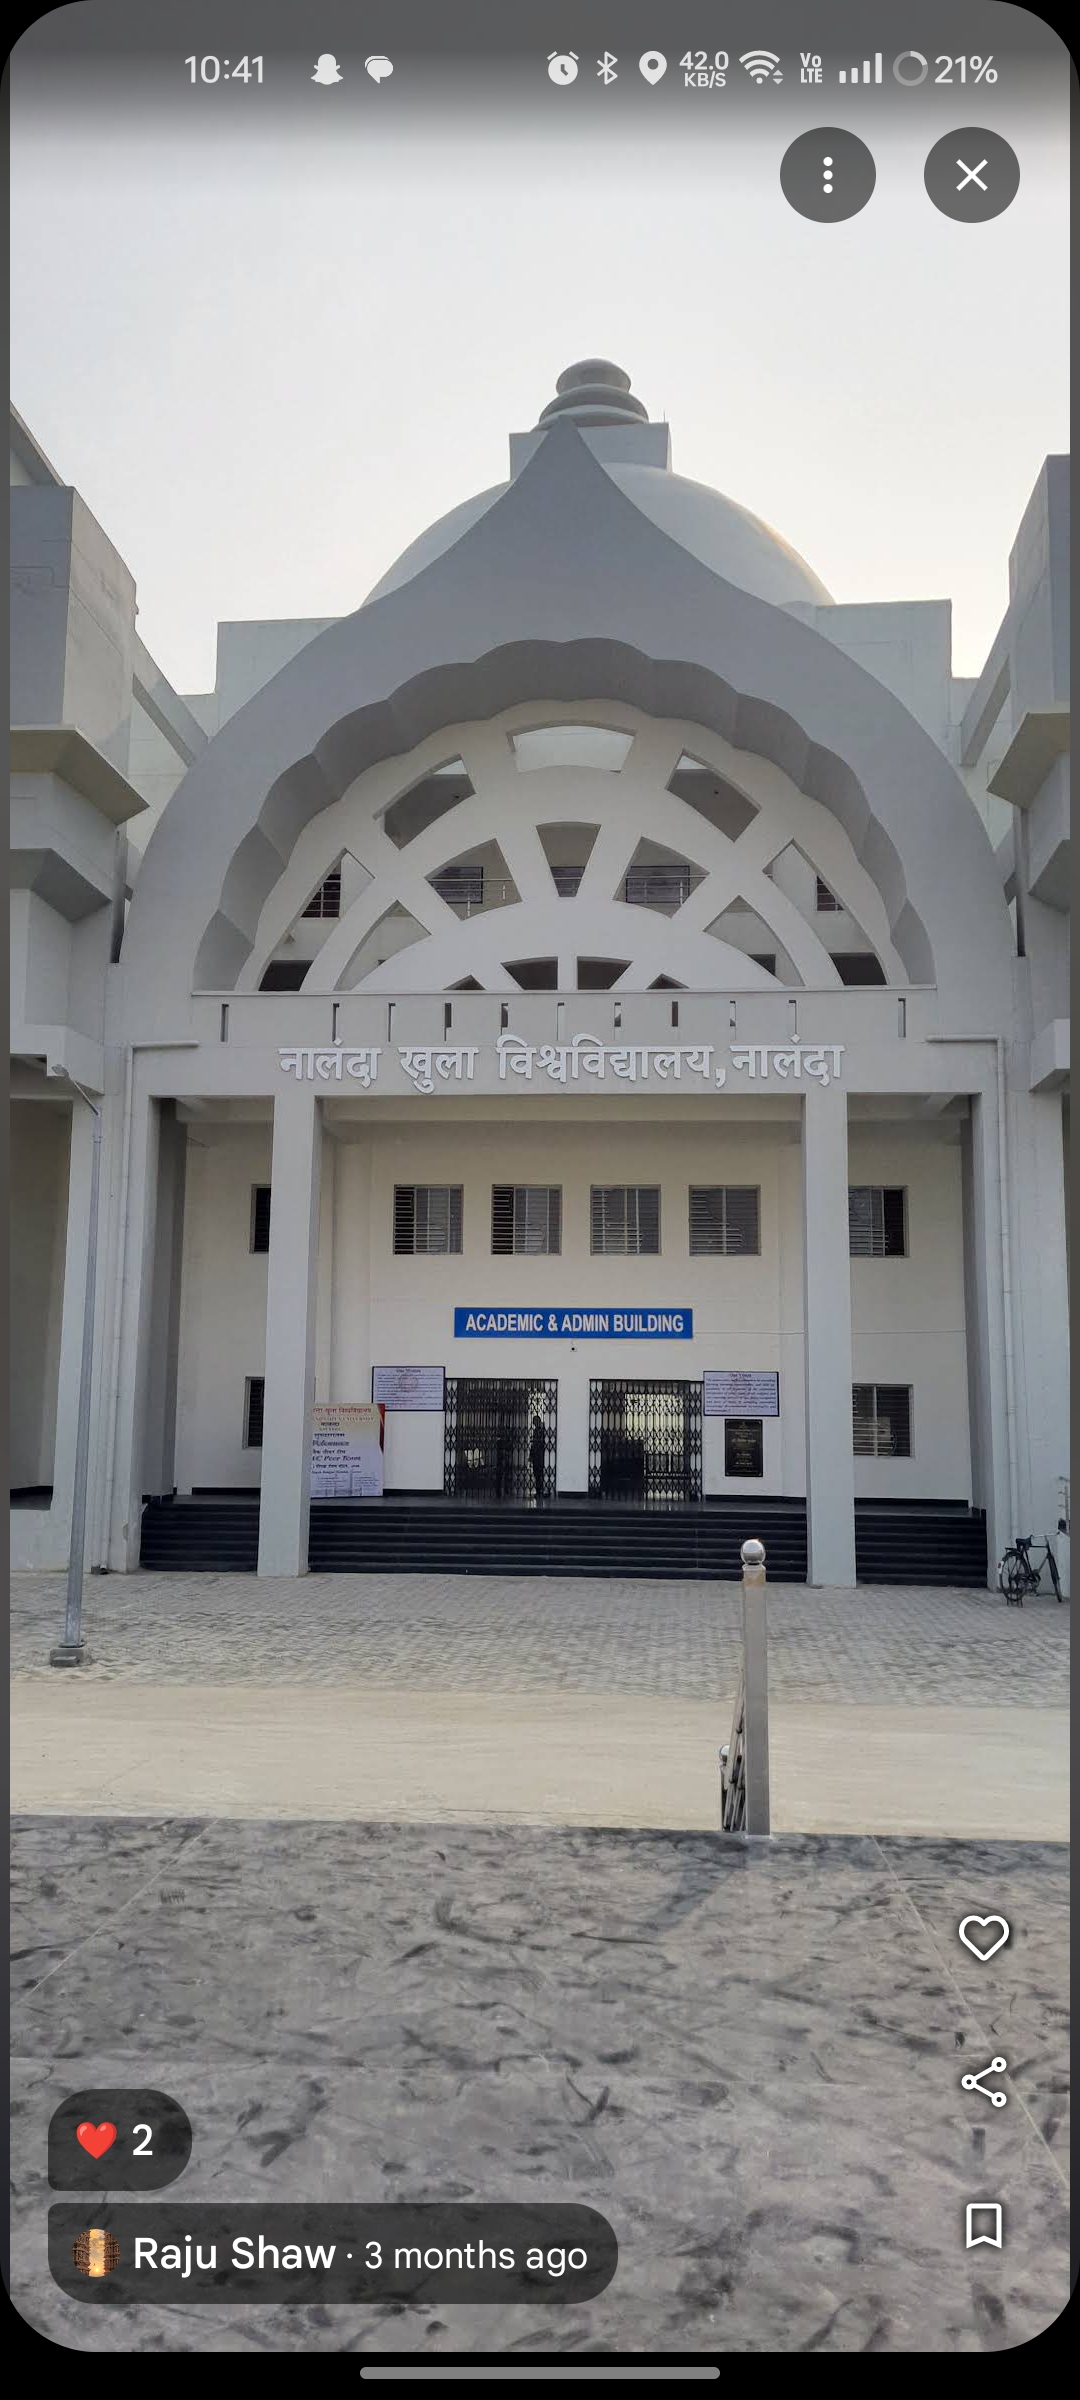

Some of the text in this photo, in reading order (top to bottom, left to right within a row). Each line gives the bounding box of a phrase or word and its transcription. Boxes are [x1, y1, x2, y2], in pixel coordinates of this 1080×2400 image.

[278, 1037, 383, 1088] नालंदा
[397, 1046, 479, 1094] खुला
[729, 1033, 846, 1087] नालंदा
[465, 1313, 684, 1333] ACADEMIC & ADMIN BUILDING
